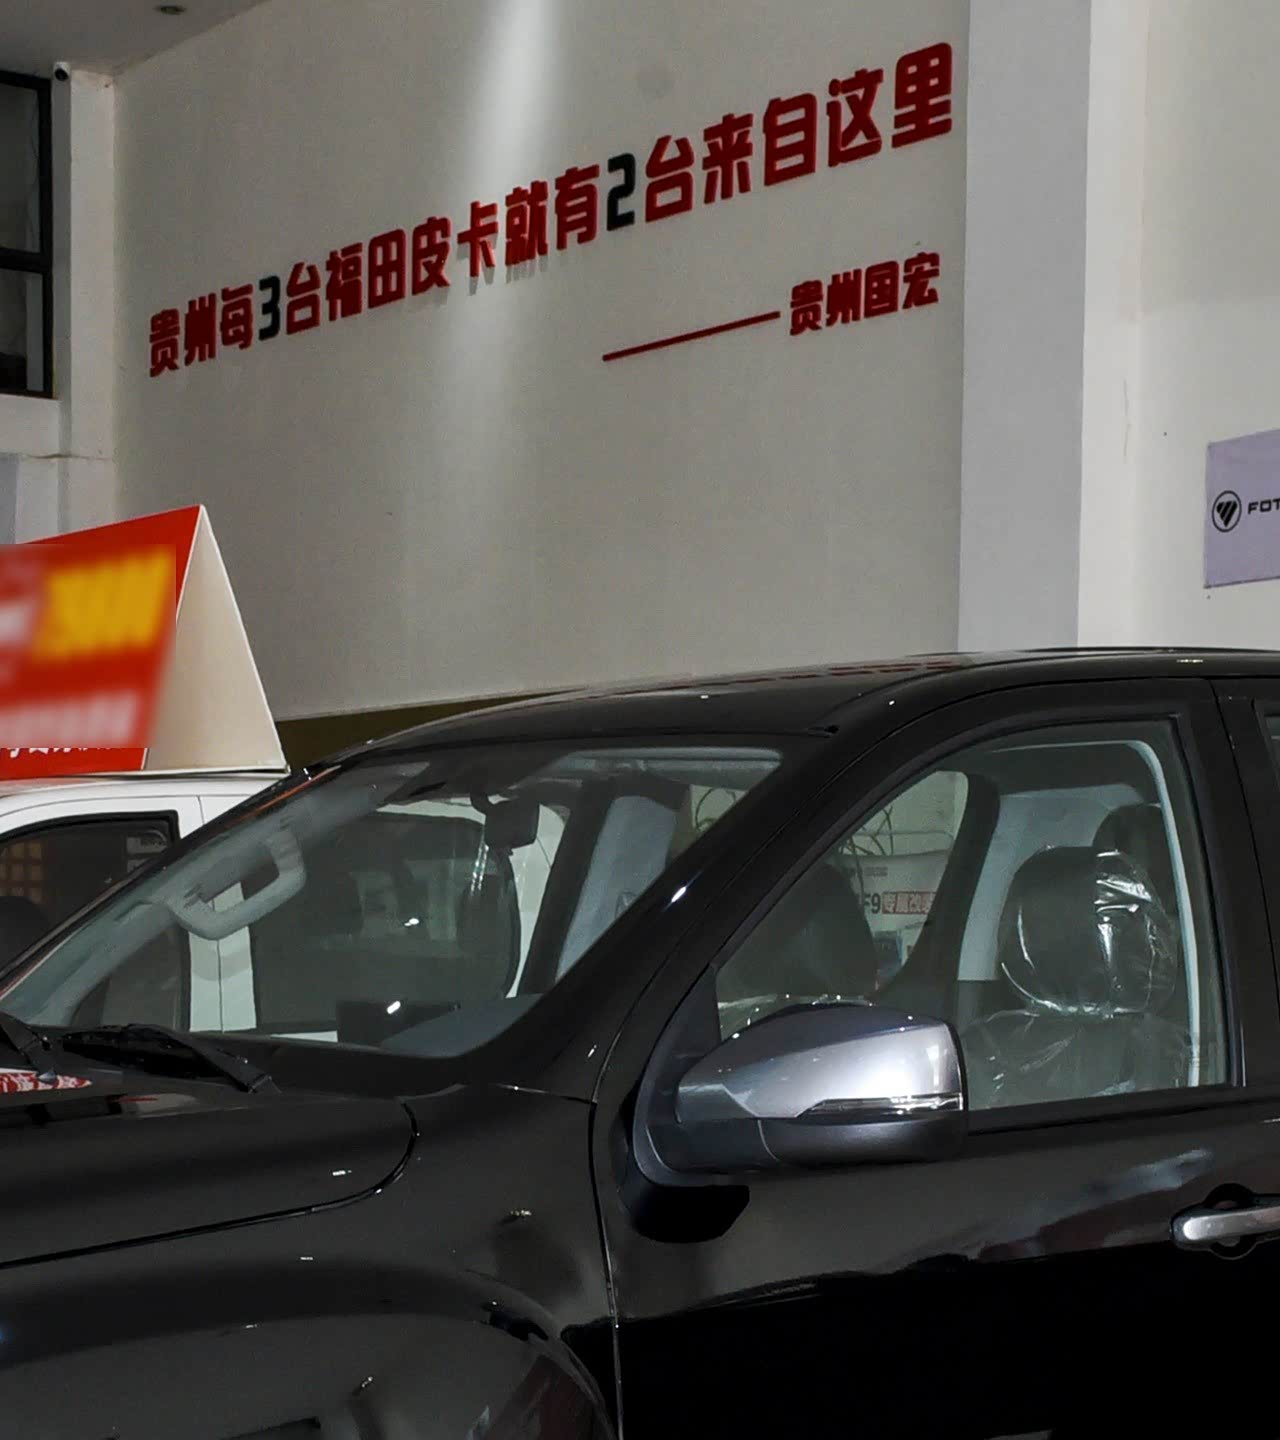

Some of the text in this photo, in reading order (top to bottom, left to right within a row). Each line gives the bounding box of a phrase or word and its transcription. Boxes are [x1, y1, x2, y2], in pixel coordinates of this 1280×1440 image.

[148, 40, 955, 378] 贵州每3台福田皮卡就有2台来自这里
